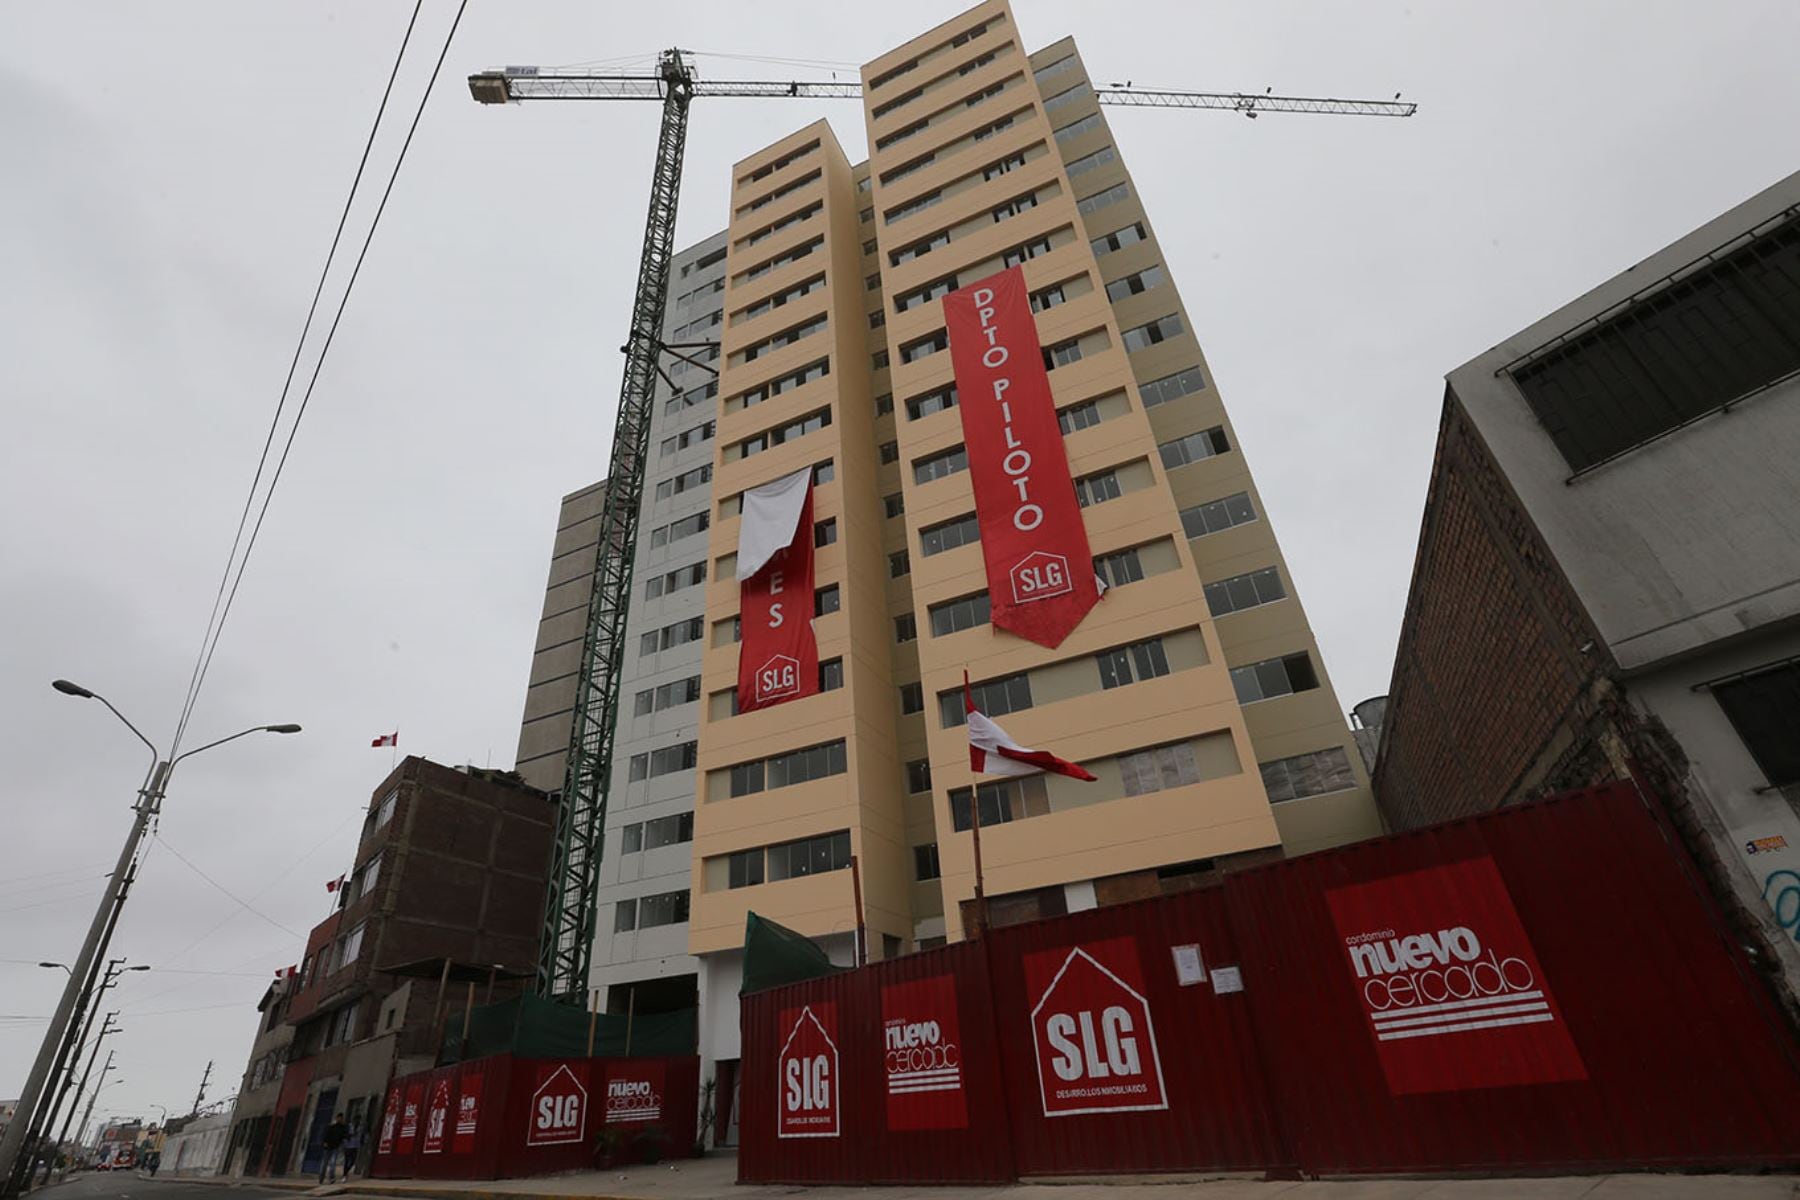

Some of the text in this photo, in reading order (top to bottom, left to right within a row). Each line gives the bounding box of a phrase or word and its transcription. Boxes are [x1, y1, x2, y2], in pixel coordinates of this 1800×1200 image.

[973, 288, 1043, 531] DPTO PILOTO
[1020, 562, 1062, 592] SLG
[762, 665, 795, 692] SLG
[1345, 928, 1396, 945] condominio
[1349, 926, 1481, 978] nuevo
[1364, 948, 1534, 1010] cercado
[885, 1020, 941, 1050] nuevo
[1046, 1005, 1142, 1081] SLG
[608, 1081, 651, 1097] nuevo
[786, 1054, 830, 1111] SLG
[537, 1094, 579, 1129] SLG
